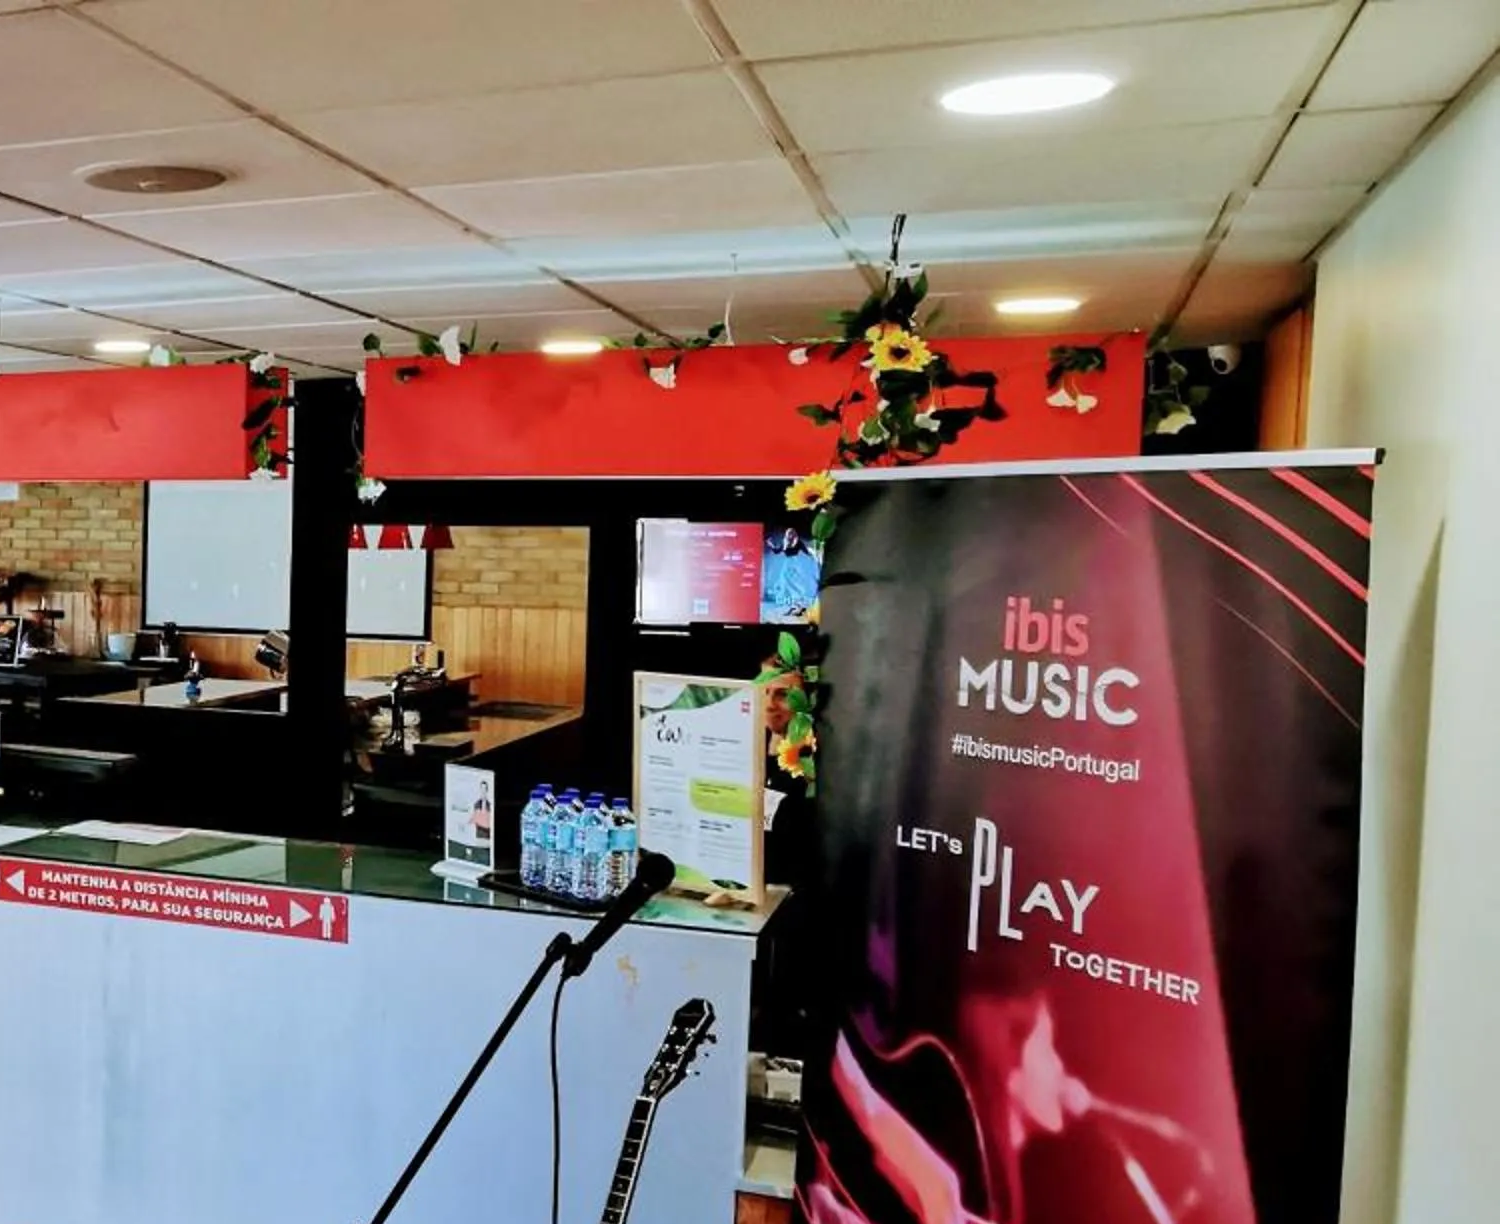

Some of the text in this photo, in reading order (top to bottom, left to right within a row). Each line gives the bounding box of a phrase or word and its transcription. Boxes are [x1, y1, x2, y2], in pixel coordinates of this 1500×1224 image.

[1004, 596, 1090, 657] ibis
[957, 656, 1141, 727] MUSIC
[951, 733, 1140, 784] #ibismusicPortugal
[28, 886, 285, 929] DE 2 METROS, PARA SUA SEGURANÇA
[41, 869, 269, 909] MANTENHA A DISTÂNCIA MÍNIMA
